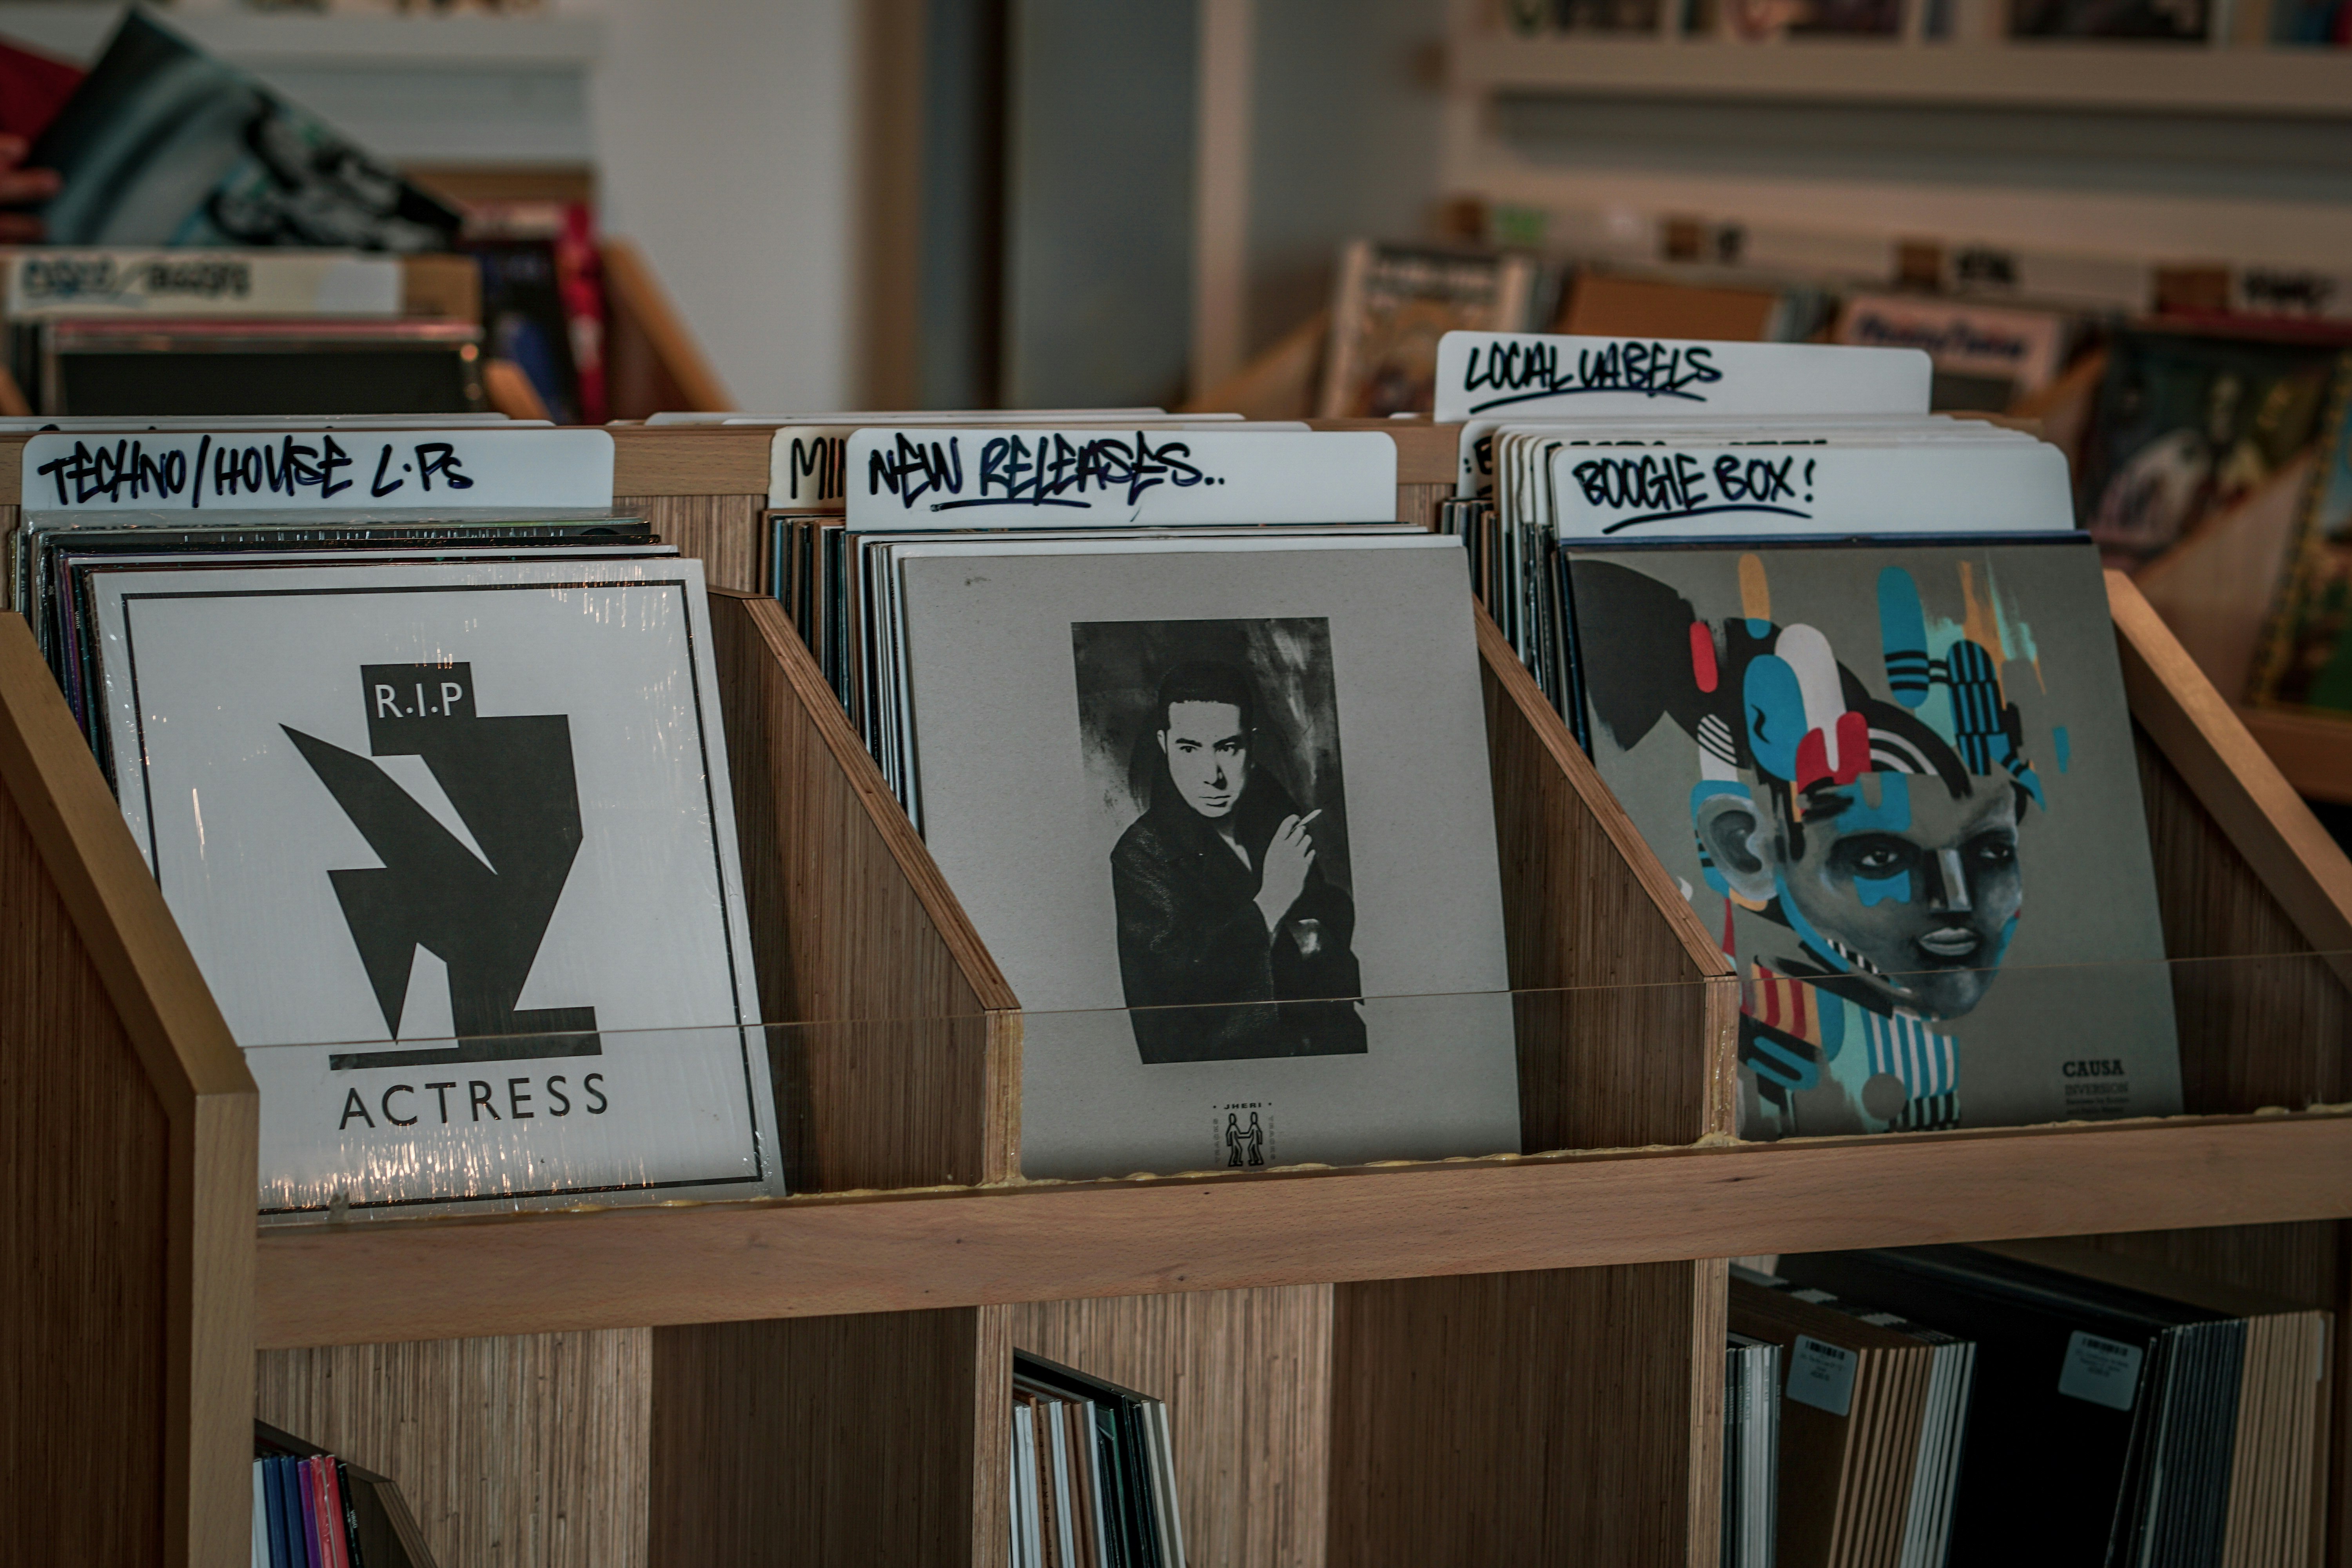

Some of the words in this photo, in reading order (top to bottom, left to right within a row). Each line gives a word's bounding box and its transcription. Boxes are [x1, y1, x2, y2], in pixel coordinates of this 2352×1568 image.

[1465, 341, 1573, 391] LOCAL
[37, 435, 353, 507] TECHNO/HOUSE
[869, 432, 963, 509] NEW
[1572, 454, 1709, 510] BOOGIE
[1713, 454, 1816, 503] BOX!
[375, 682, 463, 718] R.I.P
[2063, 1060, 2124, 1076] CAUSA
[338, 1073, 608, 1130] ACTRESS
